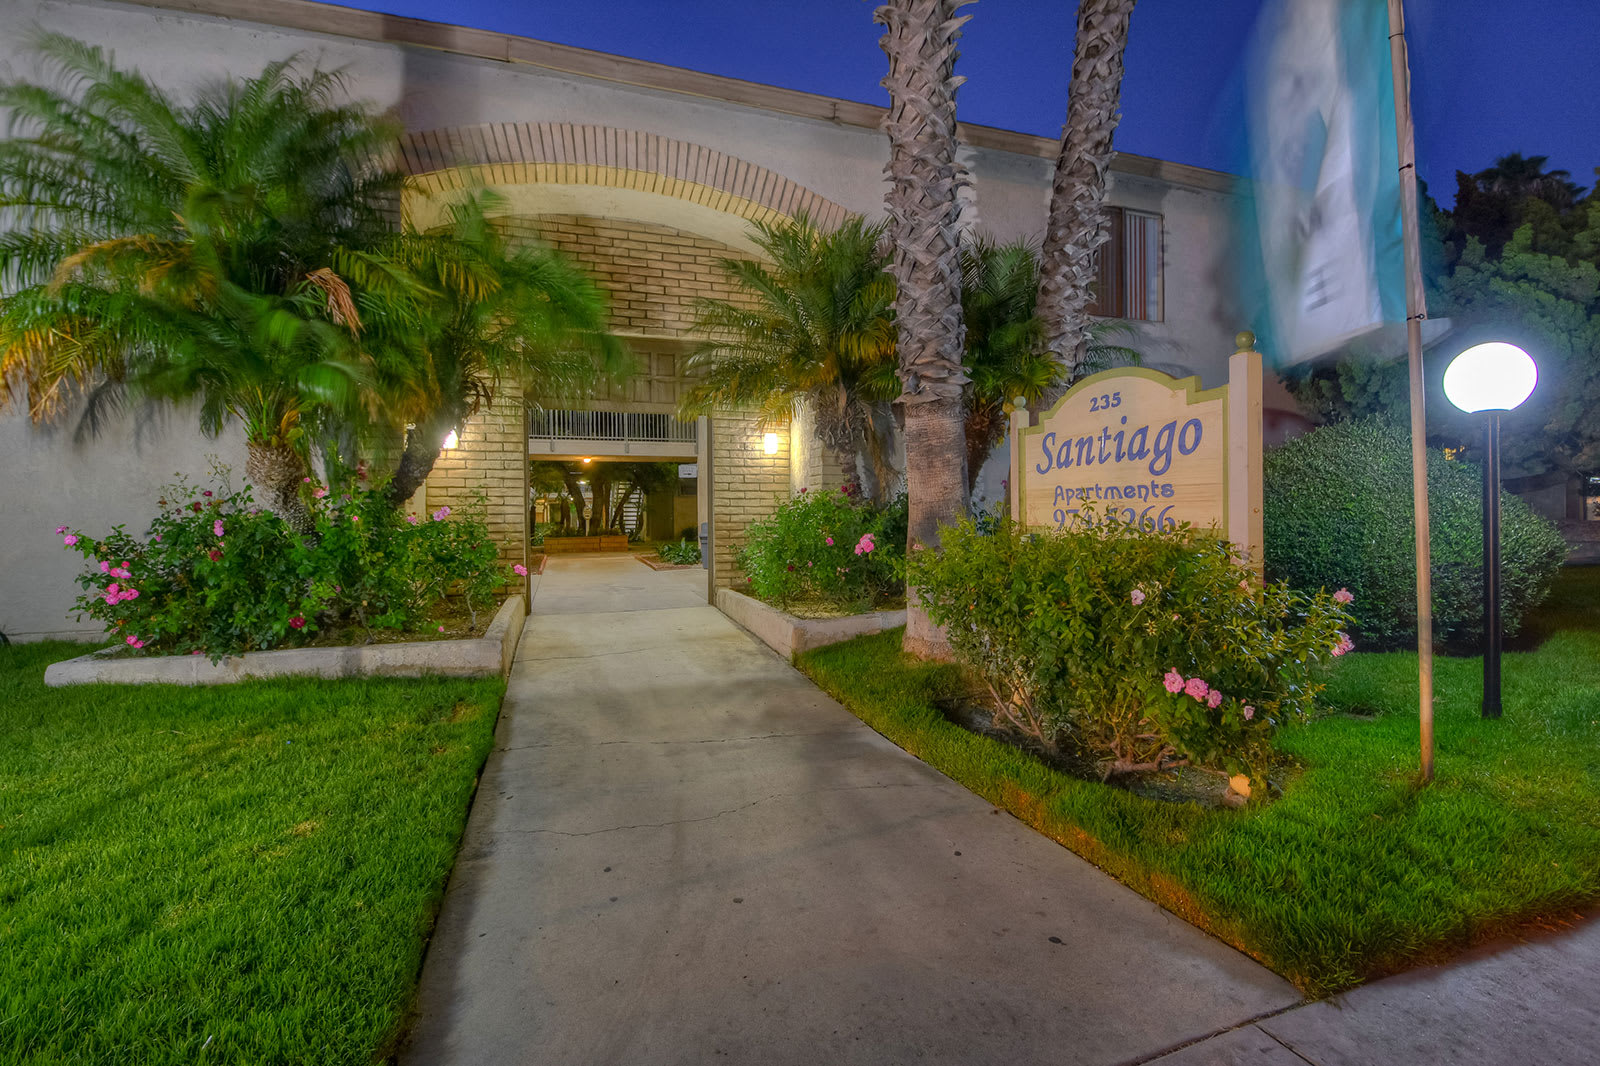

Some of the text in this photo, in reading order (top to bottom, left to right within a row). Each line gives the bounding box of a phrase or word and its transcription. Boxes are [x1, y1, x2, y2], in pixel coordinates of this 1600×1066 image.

[1089, 391, 1122, 412] 235
[1036, 415, 1203, 476] Santiago
[1053, 480, 1175, 506] Apartments
